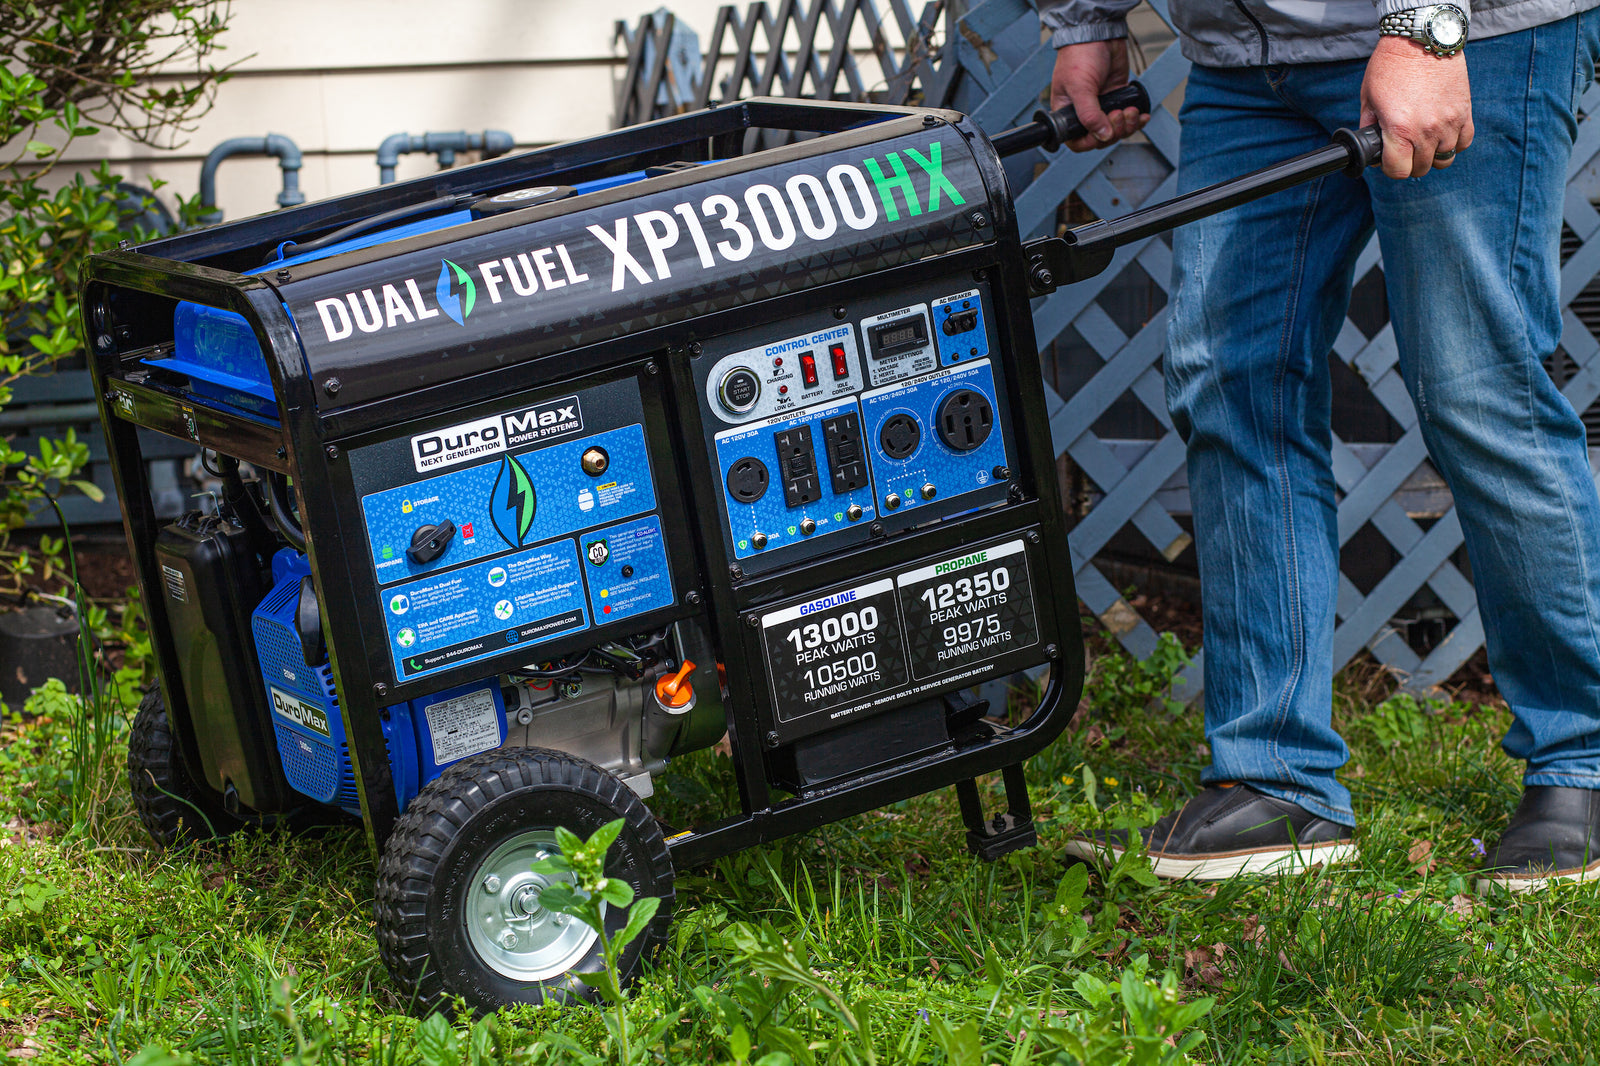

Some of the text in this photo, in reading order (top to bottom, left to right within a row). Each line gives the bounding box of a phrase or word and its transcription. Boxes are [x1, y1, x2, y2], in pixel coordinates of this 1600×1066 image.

[315, 142, 965, 342] DUAL FUEL XP13000HX
[948, 292, 972, 303] BREAKER
[877, 308, 911, 321] MULTIMETER
[766, 327, 849, 357] CONTROL CENTER
[880, 350, 924, 366] METER SETTINGS
[877, 363, 899, 373] VOLTAGE
[879, 370, 895, 378] HERTZ
[766, 373, 794, 384] CHARGING
[901, 370, 951, 388] 120/240V OUTLETS
[940, 373, 968, 385] 120/240V
[733, 387, 750, 395] START
[736, 393, 750, 401] STOP
[801, 390, 824, 400] BATTERY
[832, 385, 856, 396] CONTROL
[879, 390, 906, 402] 120/240V
[775, 404, 787, 412] LOW
[767, 411, 806, 425] 120V OUTLETS
[798, 416, 812, 425] 120V
[814, 412, 825, 420] 20A
[417, 405, 577, 459] DuroMax
[731, 434, 746, 443] 120V
[421, 421, 579, 468] NEXT GENERATION POWER SYSTEMS
[413, 496, 439, 507] STORAGE
[464, 538, 476, 546] GAS
[593, 547, 603, 558] CO
[376, 558, 403, 569] PROPANE
[517, 557, 540, 567] DuroMax
[935, 552, 988, 576] PROPANE
[515, 581, 577, 601] Lifetime Technical Support
[921, 567, 1010, 612] 12350
[800, 591, 857, 616] GASOLINE
[930, 593, 1008, 625] PEAK WATTS
[439, 615, 454, 623] CARB
[454, 608, 478, 619] Approved
[521, 617, 577, 636] DUROMAXPOWER.COM
[786, 606, 879, 652] 13000
[943, 613, 1001, 647] 9975
[796, 632, 876, 666] PEAK WATTS
[937, 631, 1012, 662] RUNNING WATTS
[425, 655, 445, 664] Support:
[803, 651, 878, 690] 10500
[804, 671, 881, 703] RUNNING WATTS
[831, 708, 853, 720] BATTERY
[854, 703, 871, 712] COVER
[874, 695, 896, 706] REMOVE
[896, 689, 913, 699] BOLTS
[920, 681, 942, 692] SERVICE
[942, 672, 972, 686] GENERATOR
[972, 664, 995, 676] BATTERY
[273, 693, 328, 732] DuroMax
